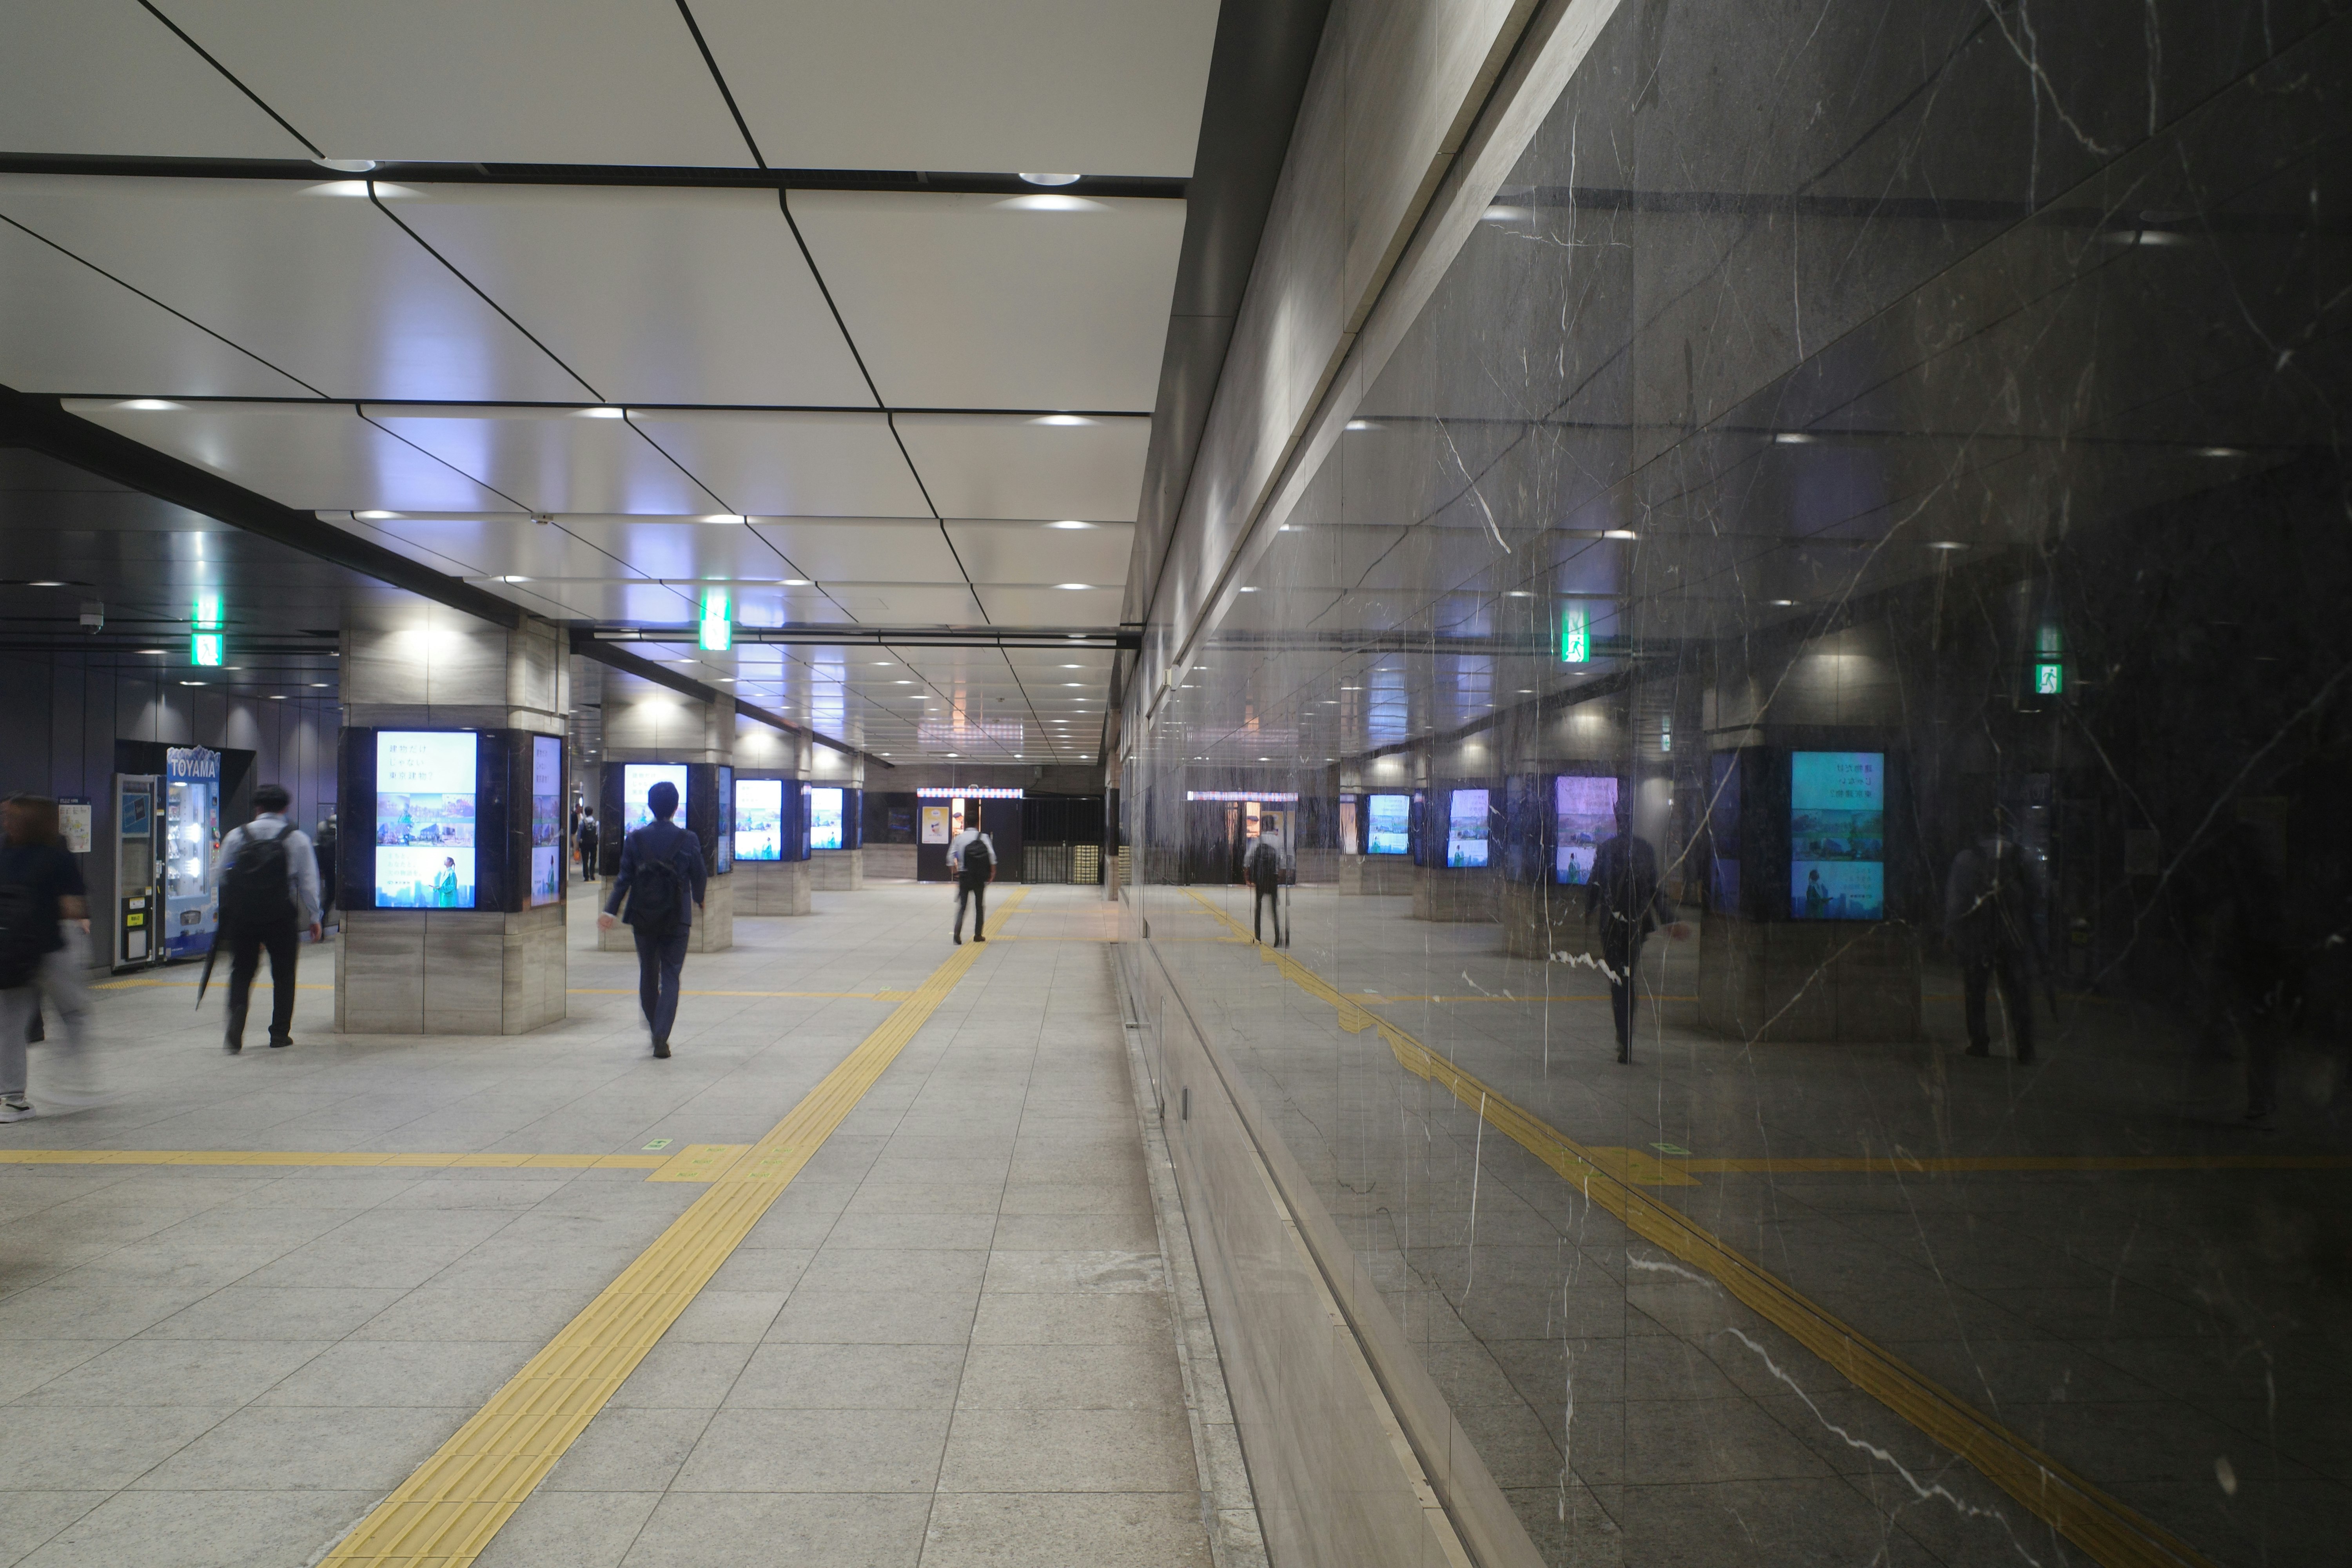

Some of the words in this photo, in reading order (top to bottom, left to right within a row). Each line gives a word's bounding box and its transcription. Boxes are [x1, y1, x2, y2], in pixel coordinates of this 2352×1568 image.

[389, 745, 426, 753] 建物だけ
[171, 759, 215, 778] TOYAMA
[389, 771, 433, 780] 東京建物？
